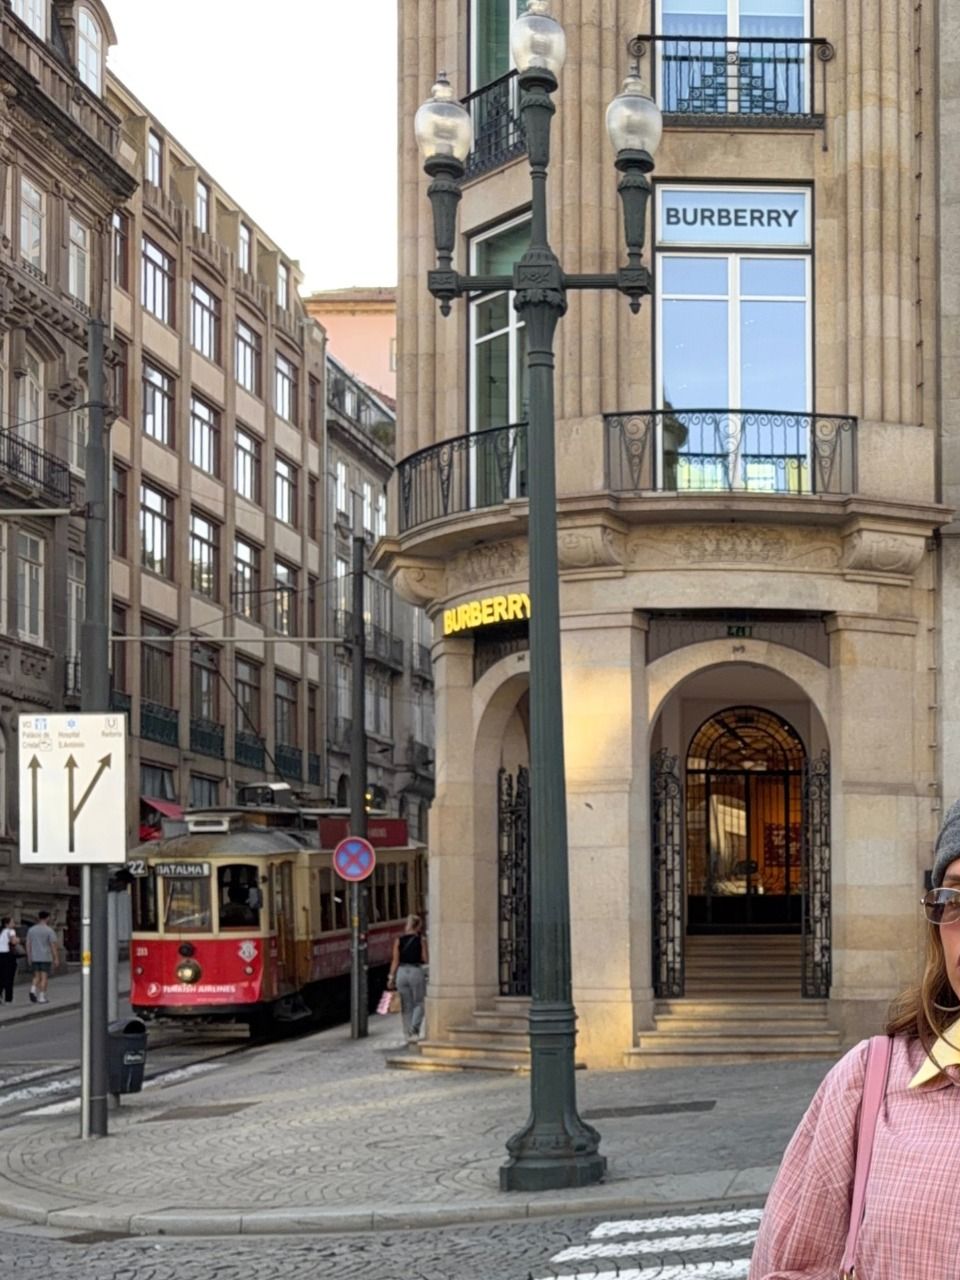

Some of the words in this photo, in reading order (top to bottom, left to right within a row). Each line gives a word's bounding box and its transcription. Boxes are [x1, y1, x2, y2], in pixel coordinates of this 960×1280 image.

[666, 207, 799, 228] BURBERRY
[128, 860, 145, 874] 22
[198, 984, 236, 993] AIRLINES
